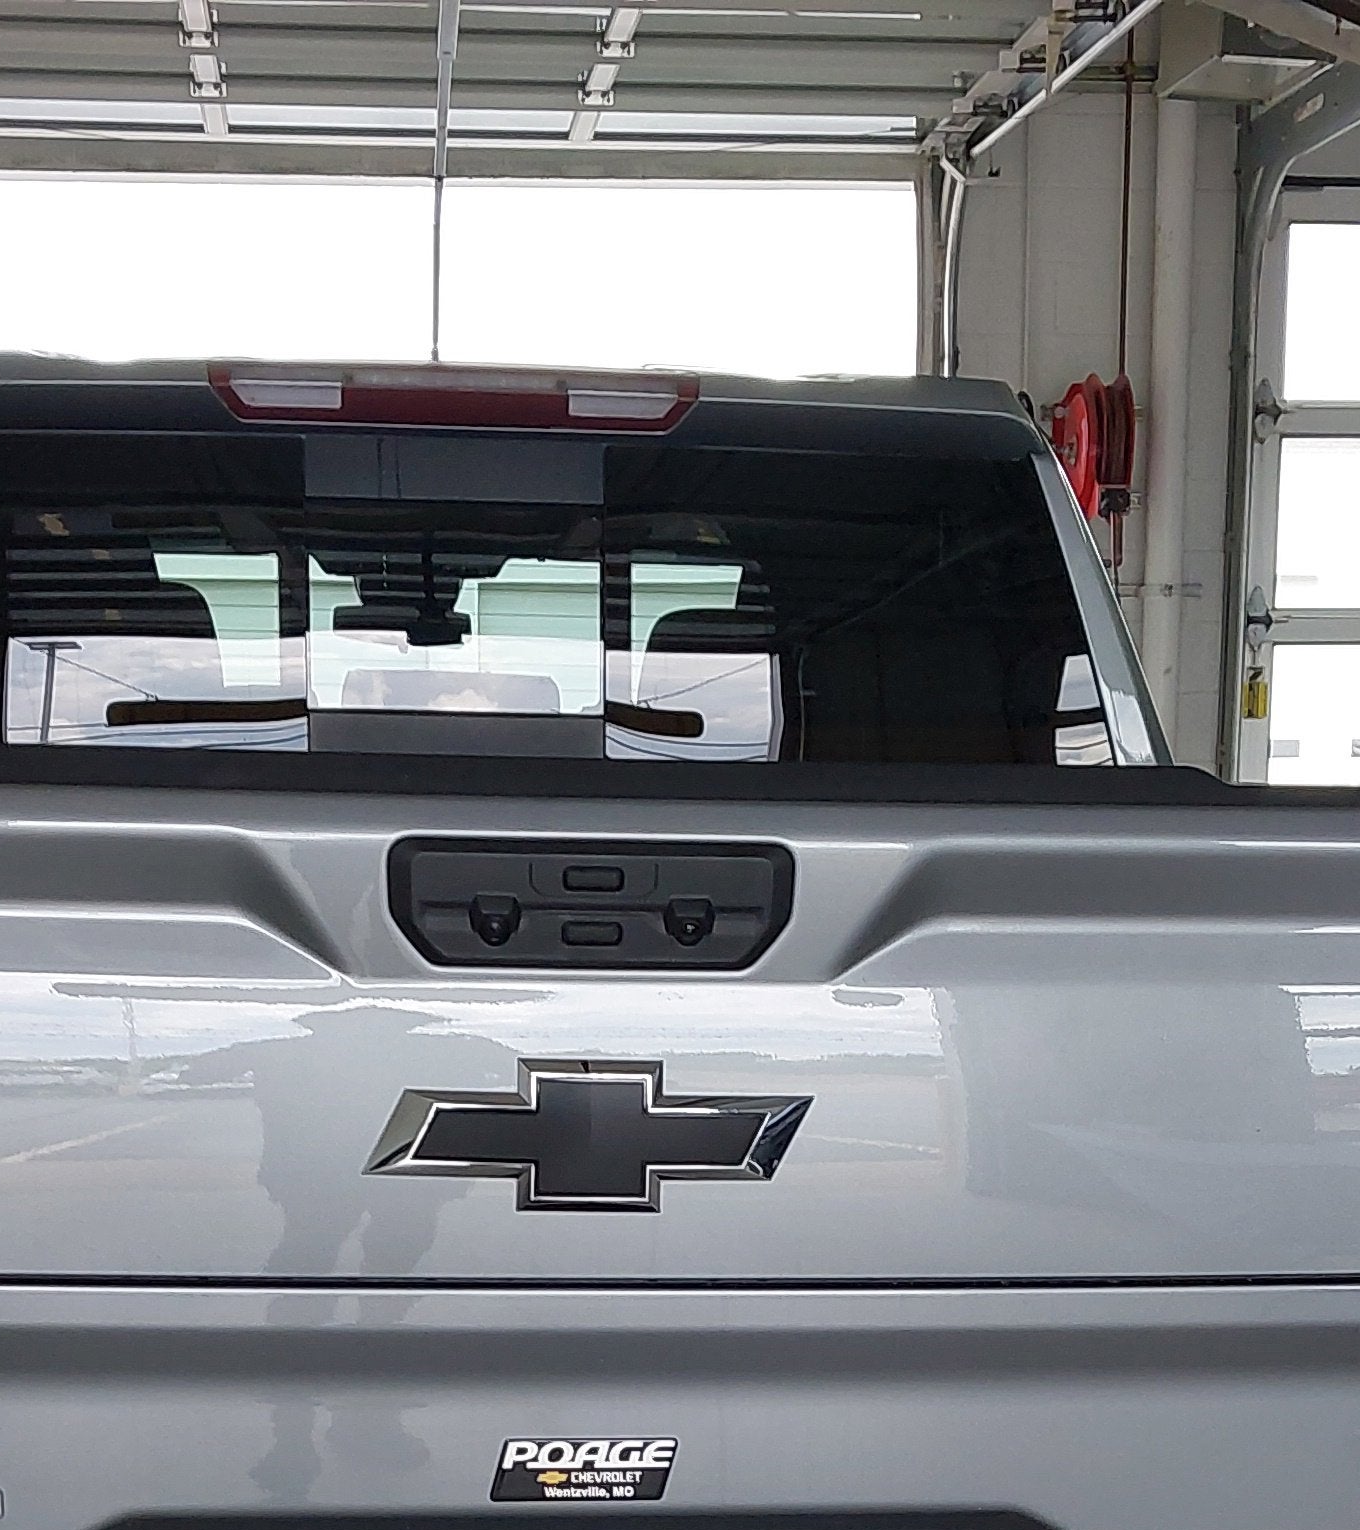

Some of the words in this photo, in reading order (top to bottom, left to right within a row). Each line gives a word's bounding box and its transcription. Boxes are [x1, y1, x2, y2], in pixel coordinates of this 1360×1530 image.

[502, 1440, 676, 1469] POAGE
[570, 1471, 643, 1484] CHEVROLET
[612, 1486, 635, 1497] MO
